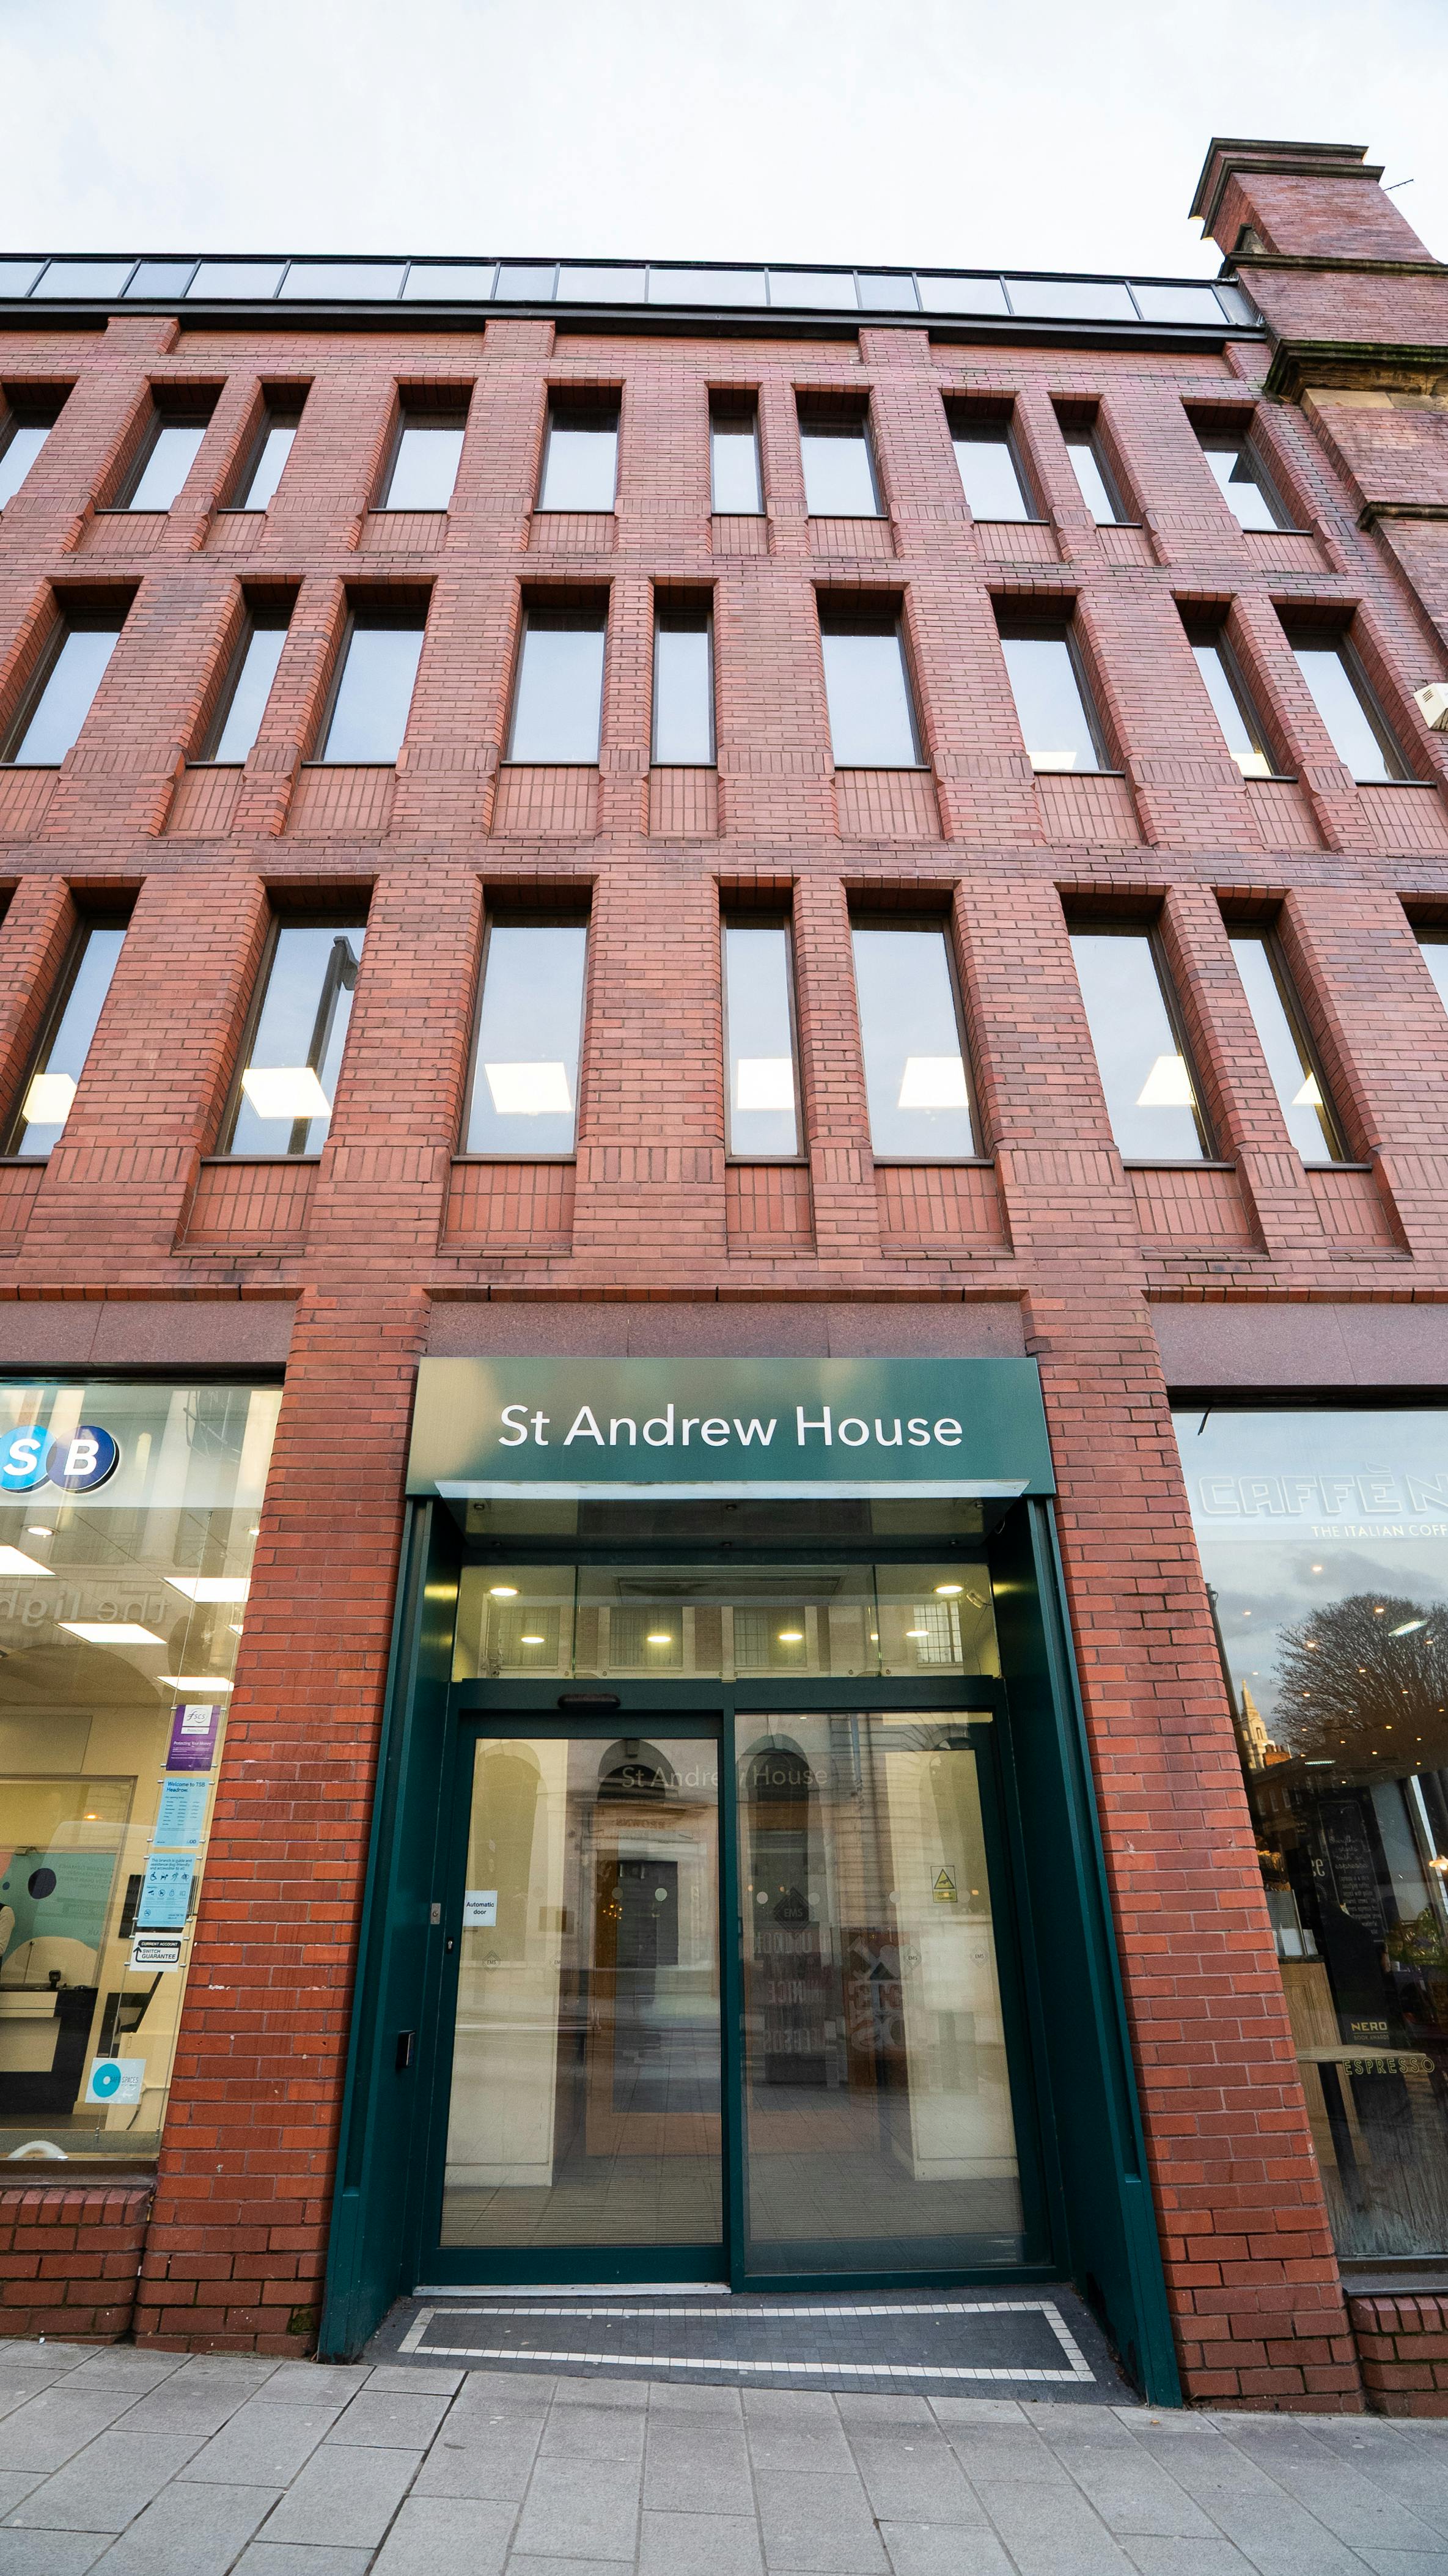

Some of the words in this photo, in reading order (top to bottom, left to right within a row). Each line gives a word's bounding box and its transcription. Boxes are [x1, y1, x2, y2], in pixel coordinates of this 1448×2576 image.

[498, 1404, 549, 1447] St
[563, 1402, 778, 1447] Andrew
[796, 1405, 963, 1447] House
[1198, 1462, 1403, 1515] CAFFÈ
[1310, 1525, 1340, 1538] THE
[1344, 1524, 1405, 1537] ITALIAN
[1408, 1524, 1448, 1537] COFF
[622, 1766, 645, 1789] St
[752, 1765, 829, 1786] House
[784, 1908, 804, 1918] EMS
[1351, 2022, 1388, 2032] NERO
[1342, 2058, 1435, 2075] ESPRESSO
